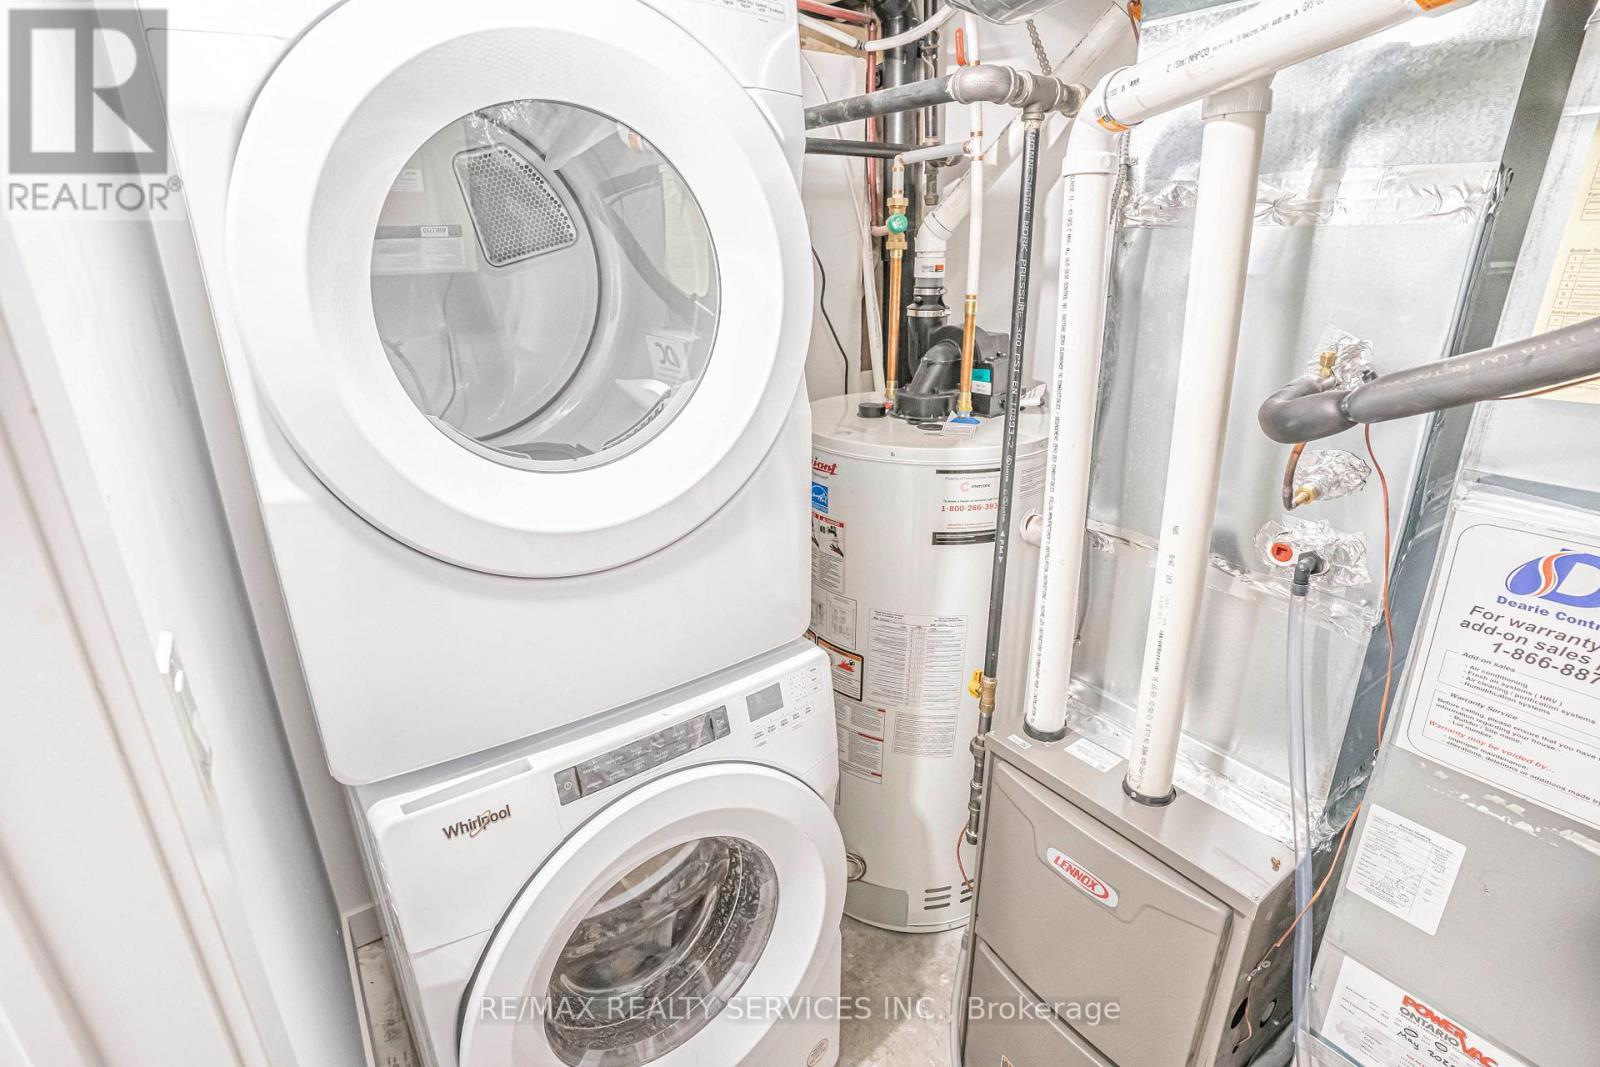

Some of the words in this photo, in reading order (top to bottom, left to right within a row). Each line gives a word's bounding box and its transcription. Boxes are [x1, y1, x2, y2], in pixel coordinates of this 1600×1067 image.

[1021, 220, 1030, 251] WORK
[1016, 258, 1027, 318] PRESSURE
[1014, 327, 1022, 346] 300
[1012, 353, 1020, 372] PSI
[1011, 380, 1019, 394] EN
[1496, 595, 1550, 617] Dearie
[1459, 619, 1529, 646] add-on
[1534, 641, 1592, 665] sales
[1469, 605, 1505, 622] For
[1509, 618, 1600, 653] warranty
[1462, 650, 1491, 665] Add-on
[1493, 661, 1515, 673] sales
[1481, 667, 1527, 688] conditioning
[1464, 680, 1516, 704] Humidification
[1518, 699, 1550, 716] systems
[1467, 669, 1488, 680] Fresh
[1501, 681, 1532, 697] systems
[1450, 691, 1485, 709] Warranty
[1487, 704, 1517, 721] Service
[1477, 679, 1508, 694] cleaning
[1514, 692, 1558, 712] purification
[1561, 708, 1595, 725] systems
[1435, 702, 1474, 721] information
[1476, 717, 1510, 734] regarding
[1512, 730, 1529, 741] your
[1437, 696, 1459, 709] Before
[1487, 715, 1511, 729] please
[1513, 724, 1539, 738] ensure
[1541, 735, 1556, 745] that
[1558, 741, 1573, 752] you
[1575, 747, 1595, 760] have
[1428, 718, 1466, 738] Warranty
[1467, 734, 1486, 746] may
[1487, 741, 1499, 751] be
[1501, 746, 1533, 765] voided
[1485, 754, 1518, 772] deletions
[1529, 772, 1565, 792] additions
[1568, 788, 1590, 801] made
[442, 804, 511, 839] Whirlpool
[1054, 856, 1099, 892] LENNOX
[1400, 1007, 1459, 1047] ONTARIO
[1397, 1031, 1419, 1050] May
[1428, 1049, 1455, 1067] 202
